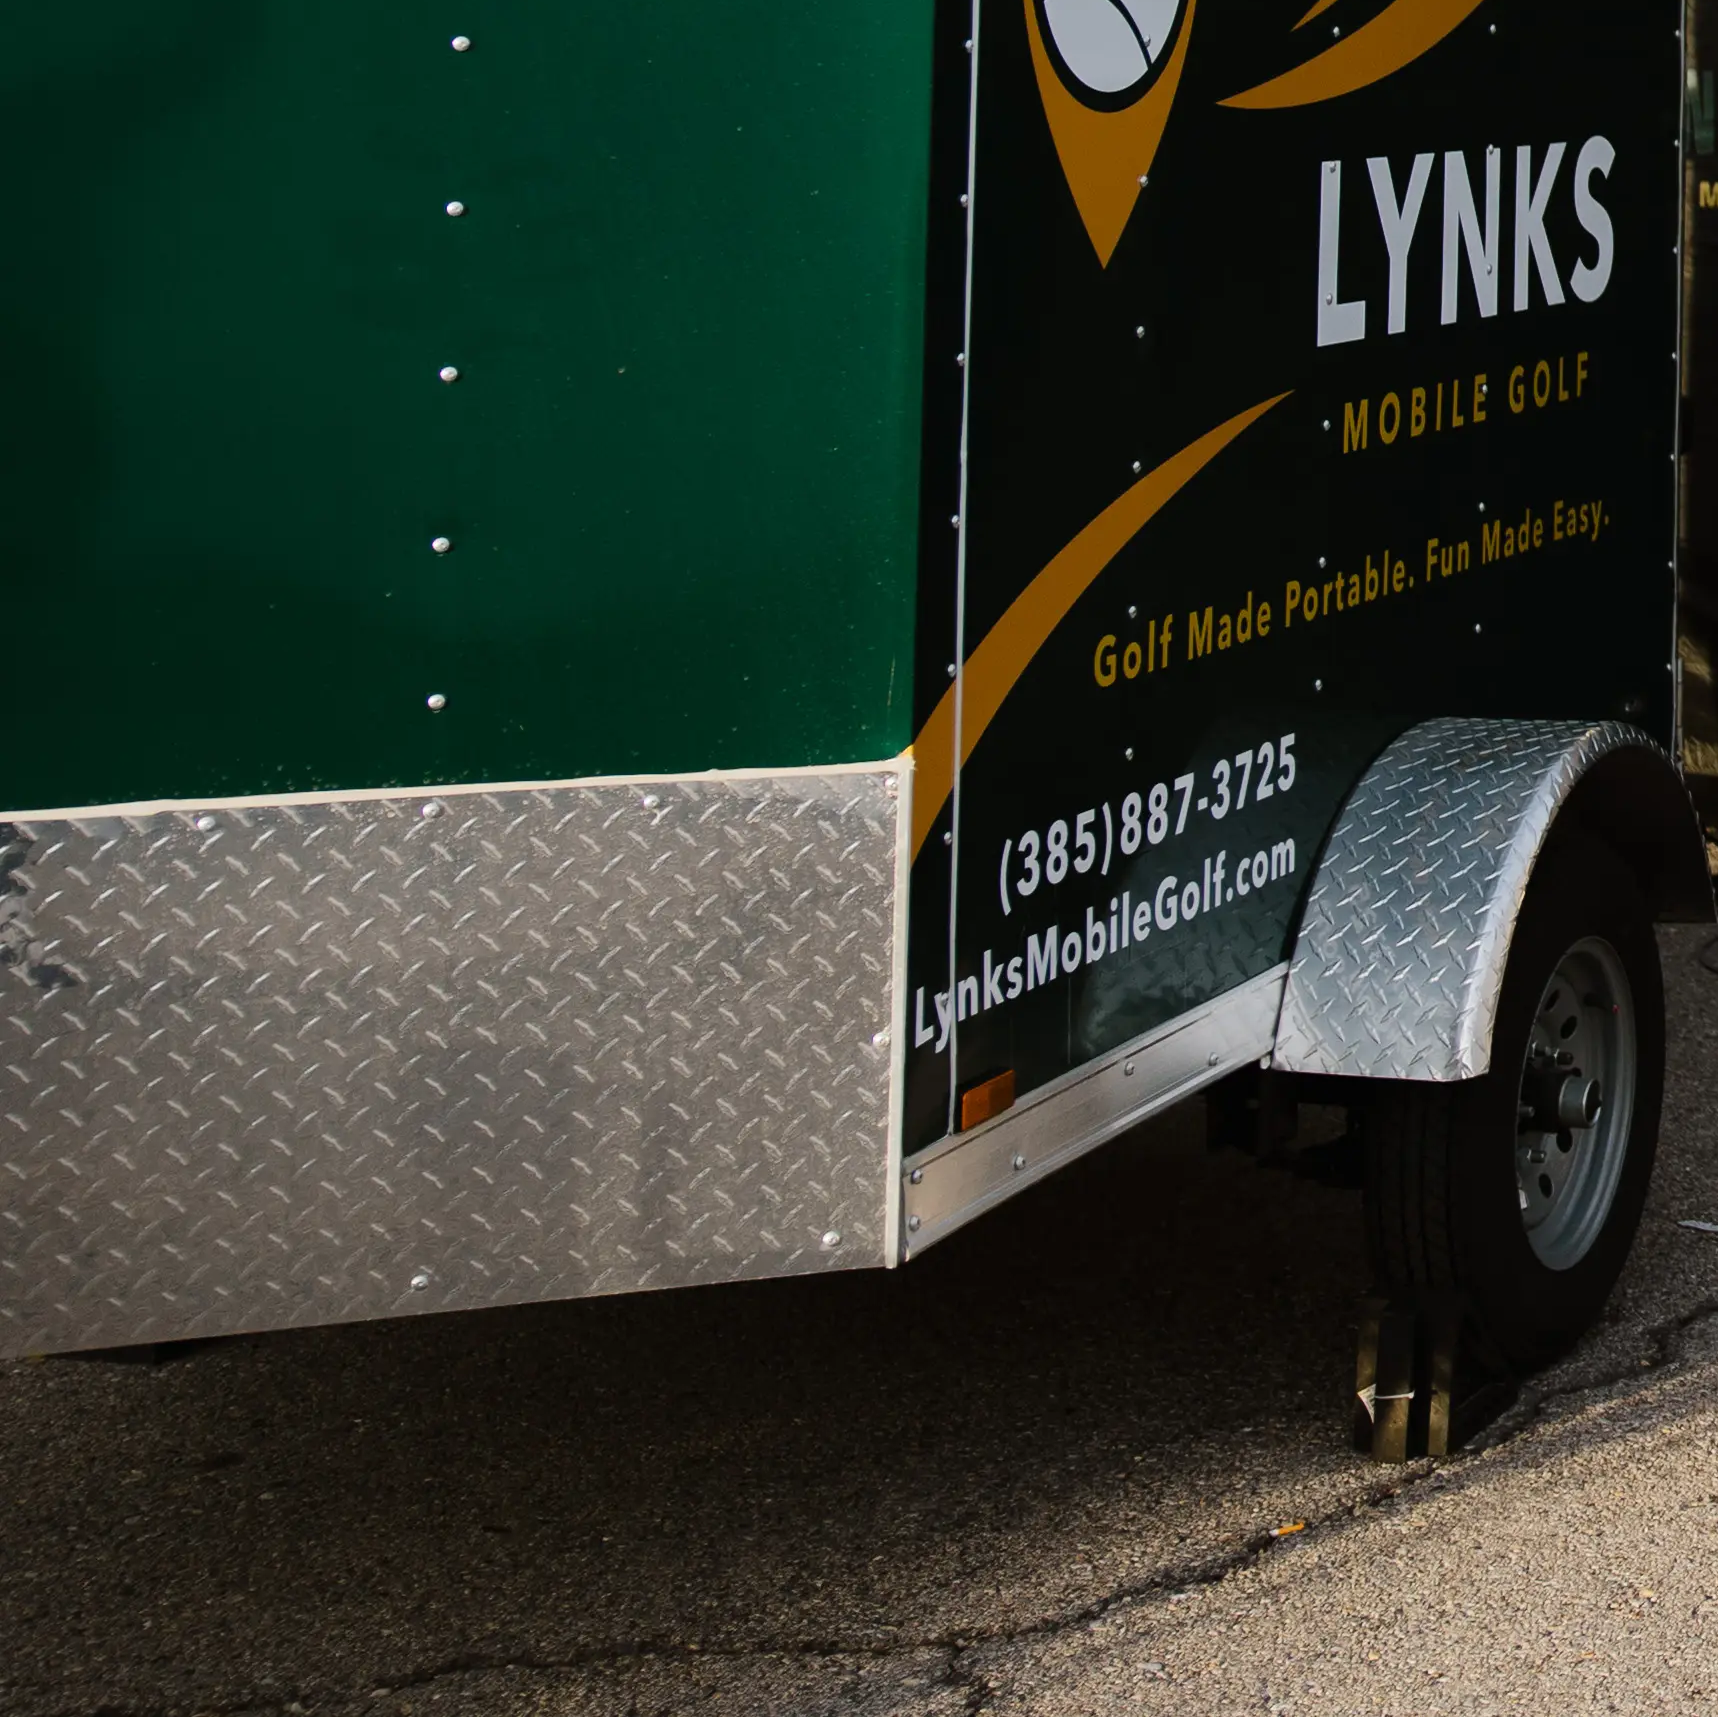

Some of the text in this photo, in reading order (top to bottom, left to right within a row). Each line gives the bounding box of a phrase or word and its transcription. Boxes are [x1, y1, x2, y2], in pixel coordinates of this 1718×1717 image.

[1317, 135, 1616, 346] LYNKS
[1343, 352, 1588, 453] MOBILE GOLF
[1094, 499, 1609, 687] Golf Made Portable. Fun Made Easy.
[1000, 733, 1296, 916] (385)887-3725
[914, 837, 1296, 1054] LynksMobileGolf.com
